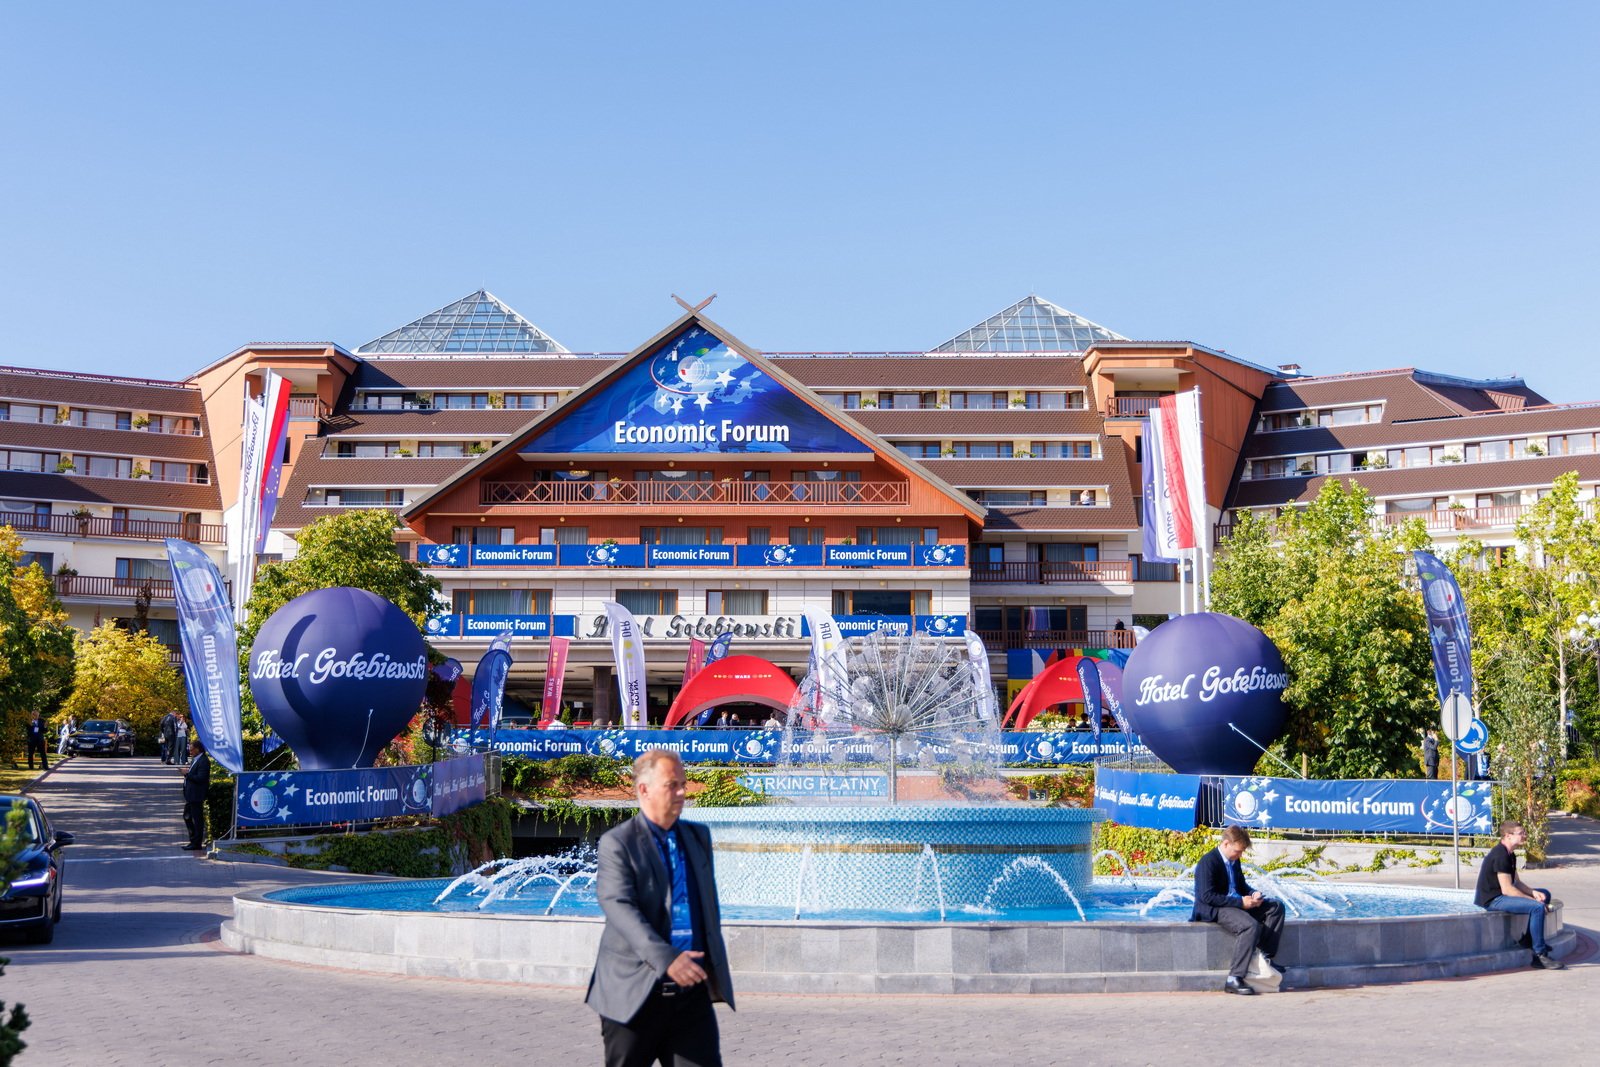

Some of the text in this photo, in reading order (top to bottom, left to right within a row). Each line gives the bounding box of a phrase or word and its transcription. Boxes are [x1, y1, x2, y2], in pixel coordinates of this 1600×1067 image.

[615, 419, 790, 444] Economic Forum
[476, 549, 553, 560] Economic Forum
[652, 549, 730, 560] Economic Forum
[829, 549, 907, 560] Economic Forum
[467, 618, 546, 630] Economic Forum
[836, 619, 909, 631] conomic Forum
[252, 649, 309, 680] Hotel
[309, 647, 426, 685] Gołębiewski
[1135, 665, 1290, 706] Hotel Gołębiews
[544, 739, 582, 752] Forum
[691, 740, 729, 753] Forum
[837, 741, 873, 754] orum
[744, 776, 881, 791] PARKING PŁATNY
[305, 785, 398, 806] Economic Forum
[1285, 793, 1416, 816] Economic Forum
